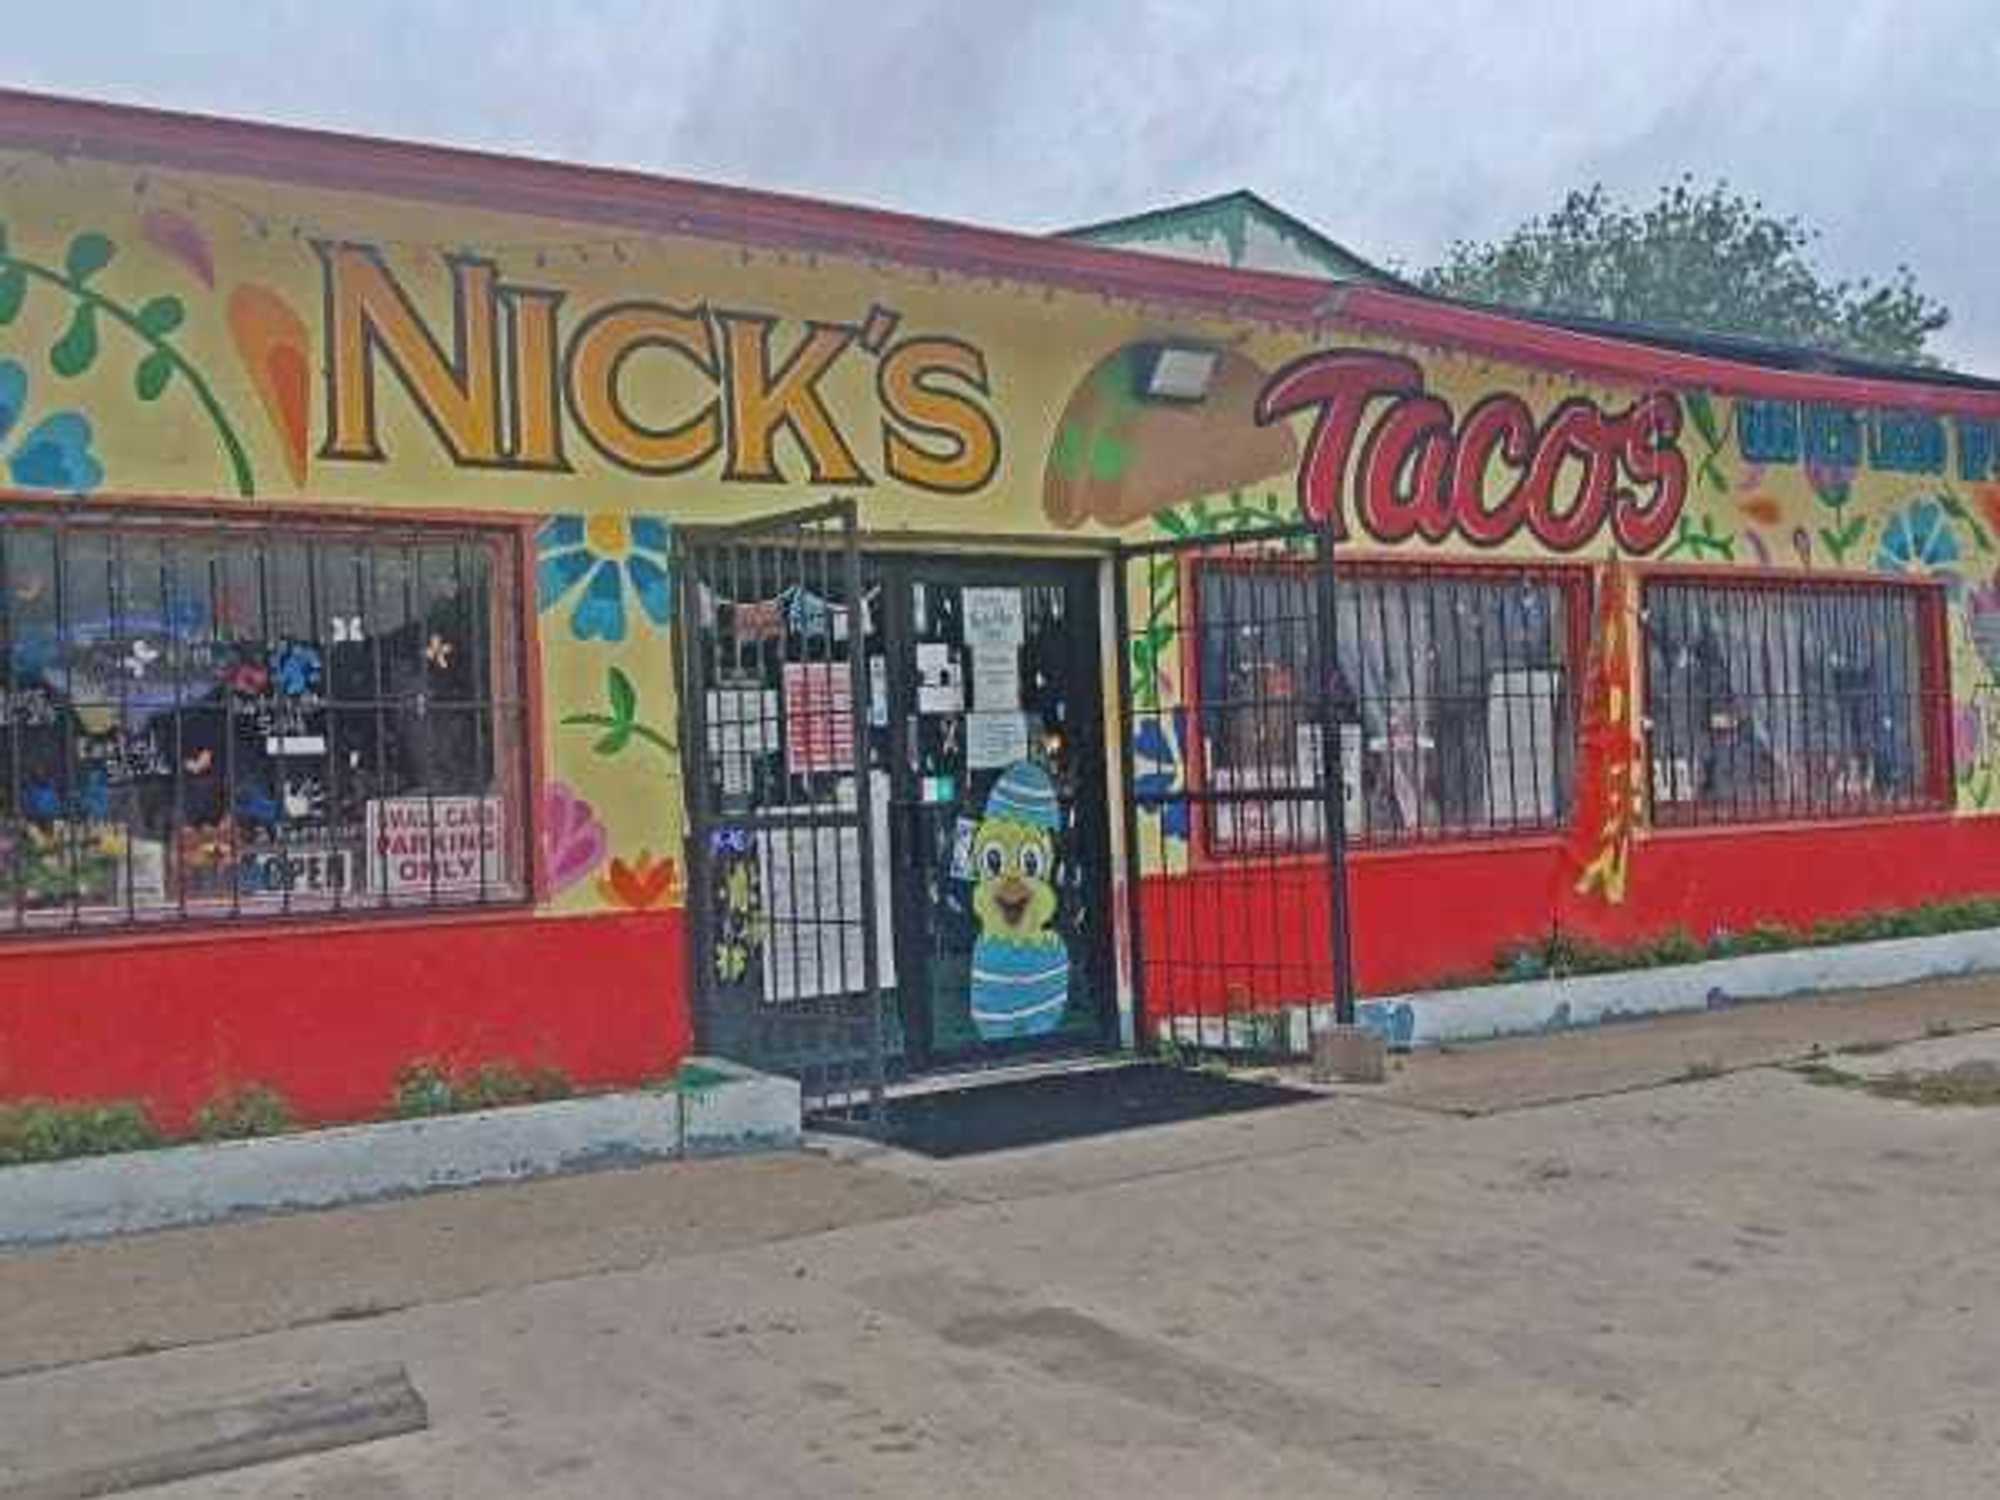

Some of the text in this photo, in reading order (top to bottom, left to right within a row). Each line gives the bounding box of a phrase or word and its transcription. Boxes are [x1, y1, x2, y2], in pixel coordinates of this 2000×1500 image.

[309, 239, 1002, 495] NICK'S
[1253, 346, 1688, 556] Tacos
[377, 830, 495, 857] PARKING
[262, 852, 345, 891] OPEN
[399, 855, 476, 881] ONLY
